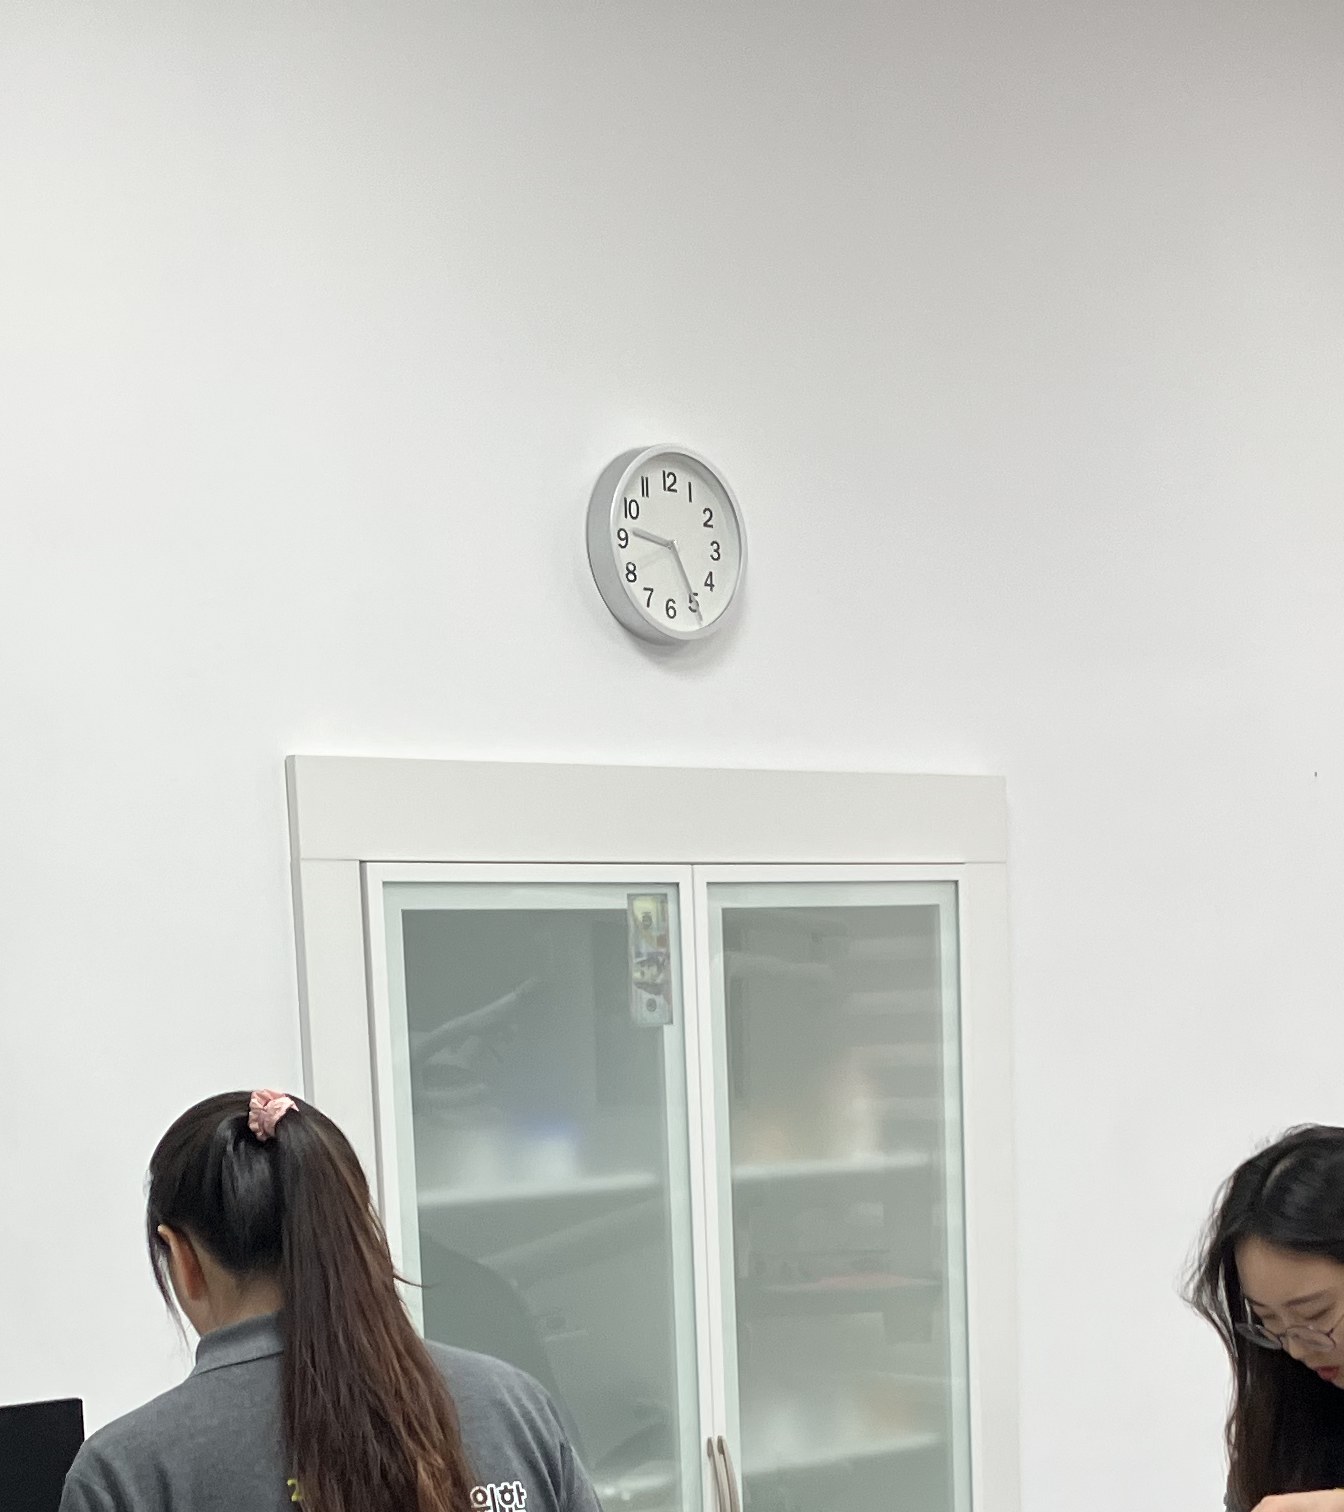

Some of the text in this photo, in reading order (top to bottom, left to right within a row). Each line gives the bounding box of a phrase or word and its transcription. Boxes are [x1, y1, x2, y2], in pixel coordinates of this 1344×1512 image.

[640, 475, 649, 498] 11
[662, 470, 677, 493] 12
[687, 481, 693, 503] 1
[623, 497, 640, 520] 10
[702, 507, 714, 528] 2
[617, 528, 629, 549] 9
[710, 540, 721, 561] 3
[625, 562, 637, 583] 8
[704, 571, 715, 592] 4
[643, 587, 654, 608] 7
[688, 592, 700, 613] 5
[665, 598, 677, 619] 6
